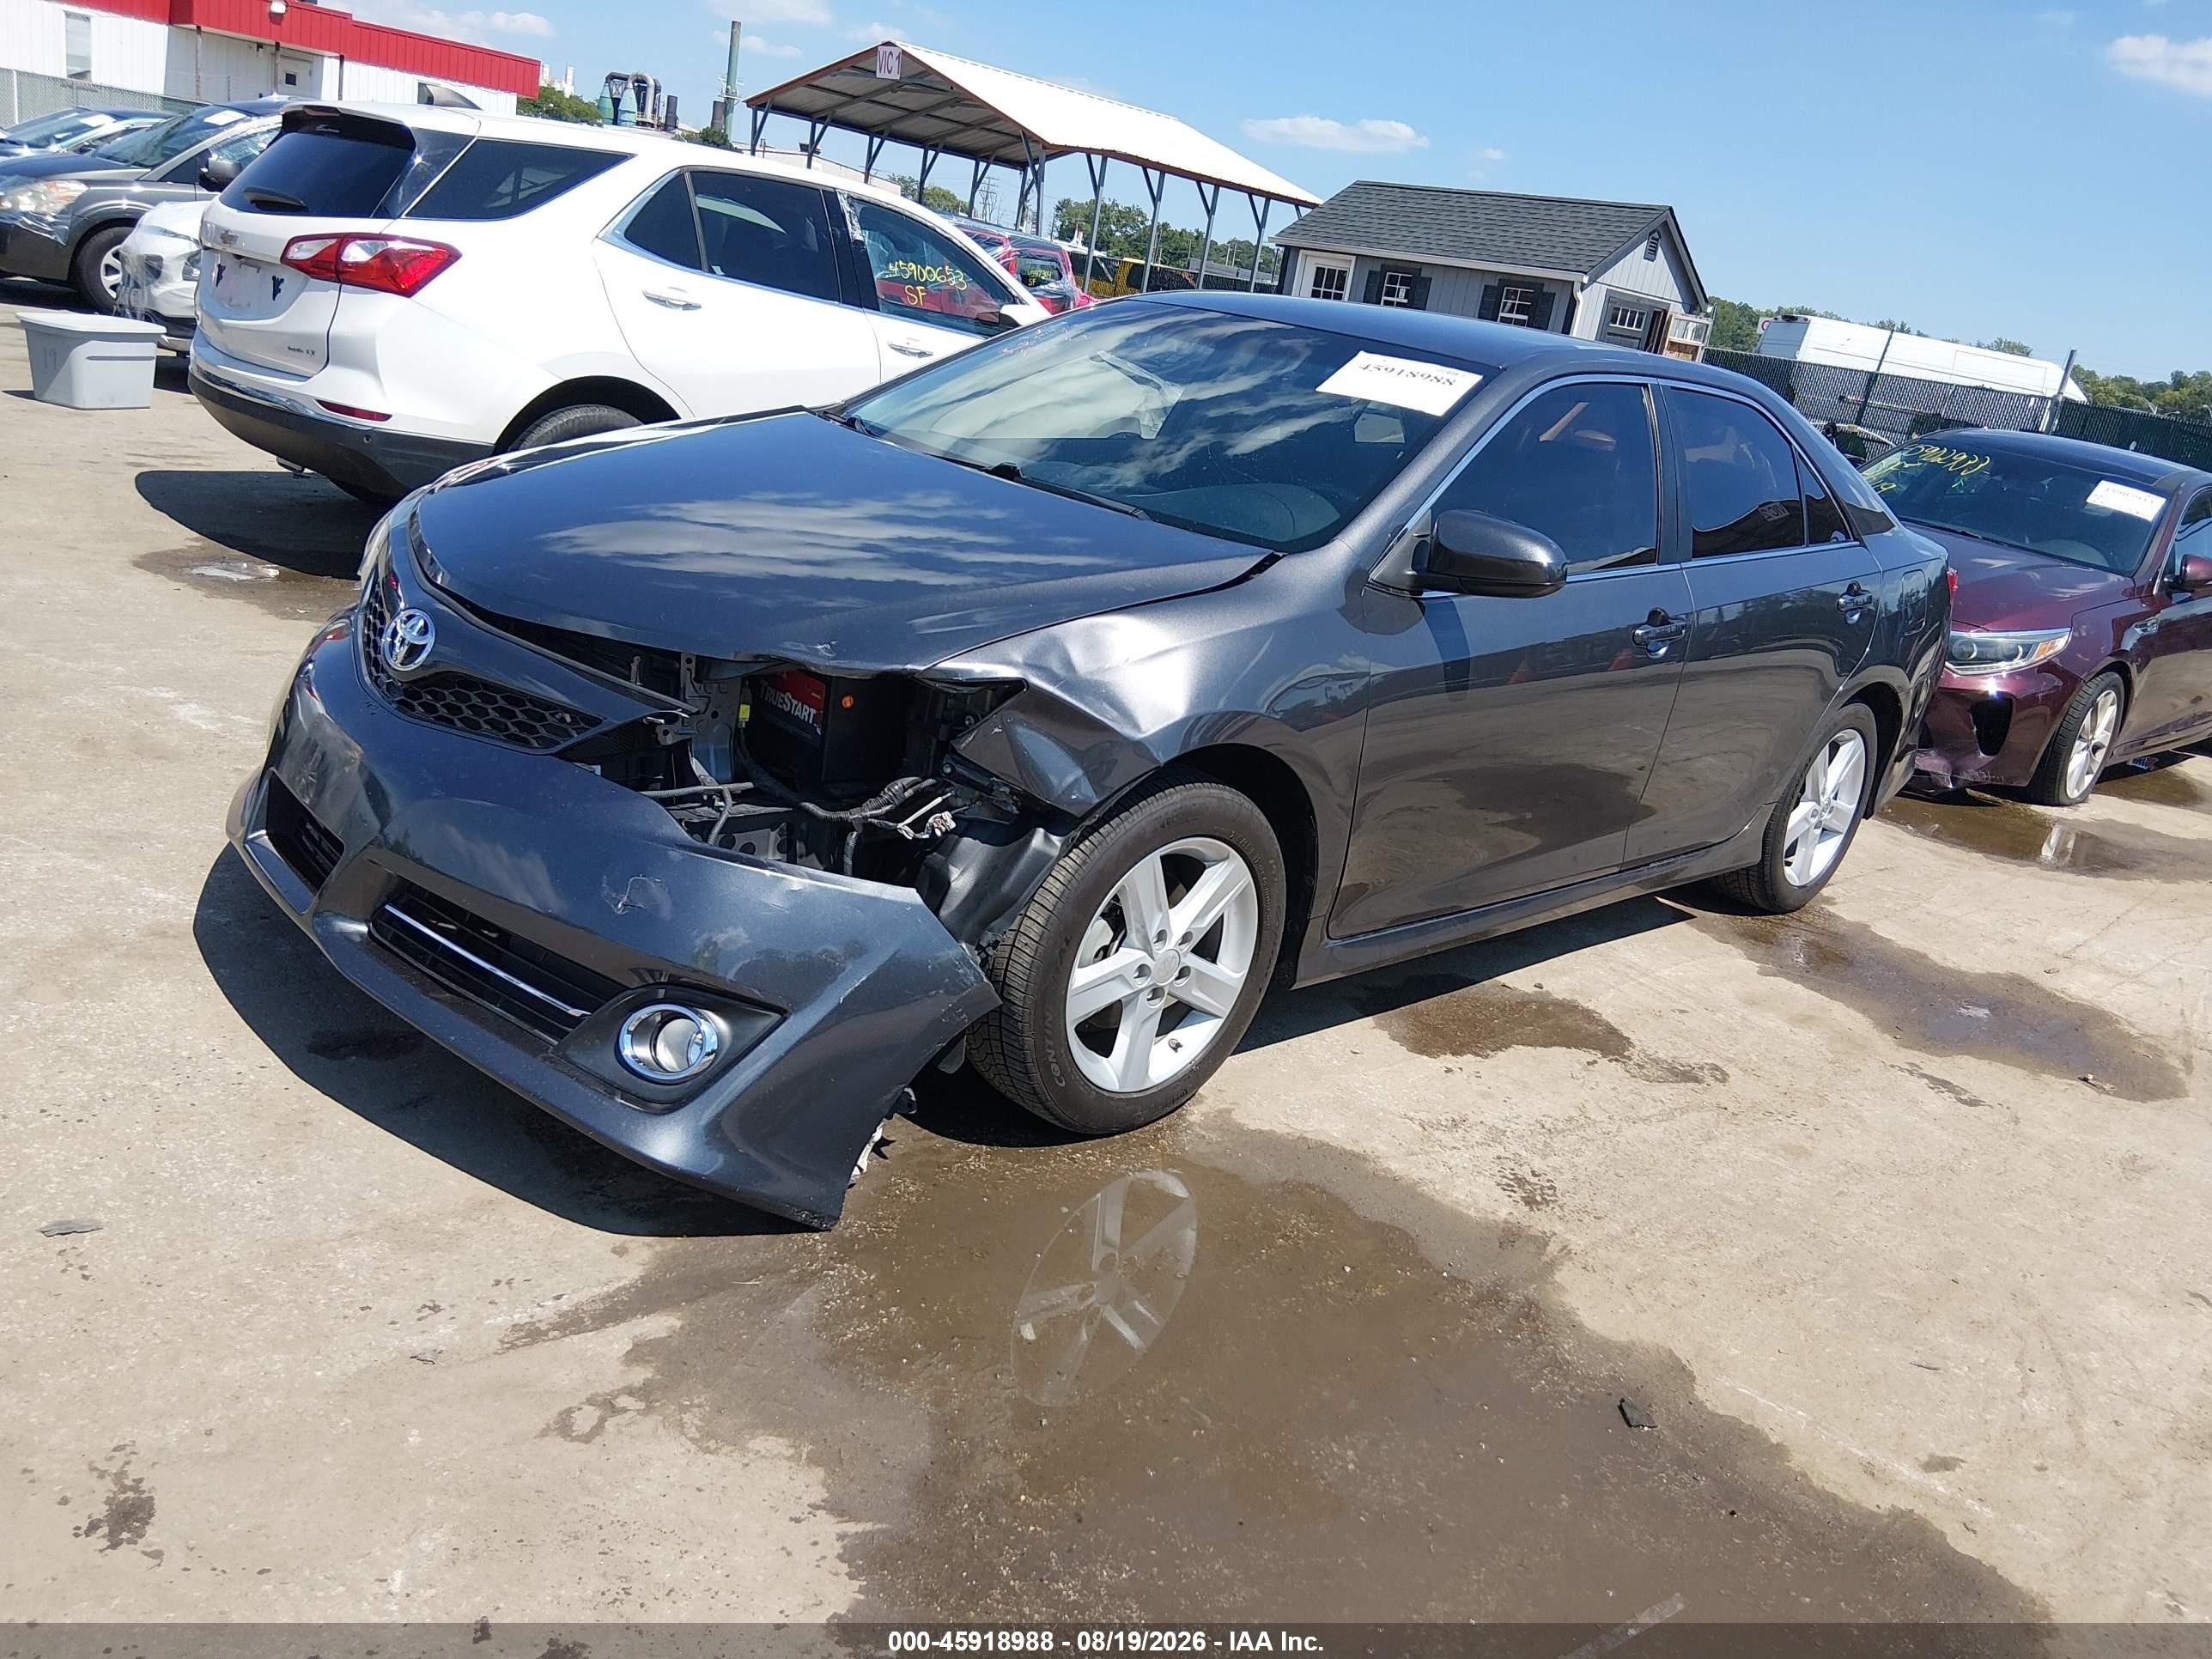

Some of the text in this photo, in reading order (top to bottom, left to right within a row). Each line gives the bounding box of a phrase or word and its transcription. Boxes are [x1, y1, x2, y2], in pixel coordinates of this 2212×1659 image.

[878, 50, 901, 75] VIC 1
[888, 260, 968, 290] 45900653
[904, 285, 927, 307] SF
